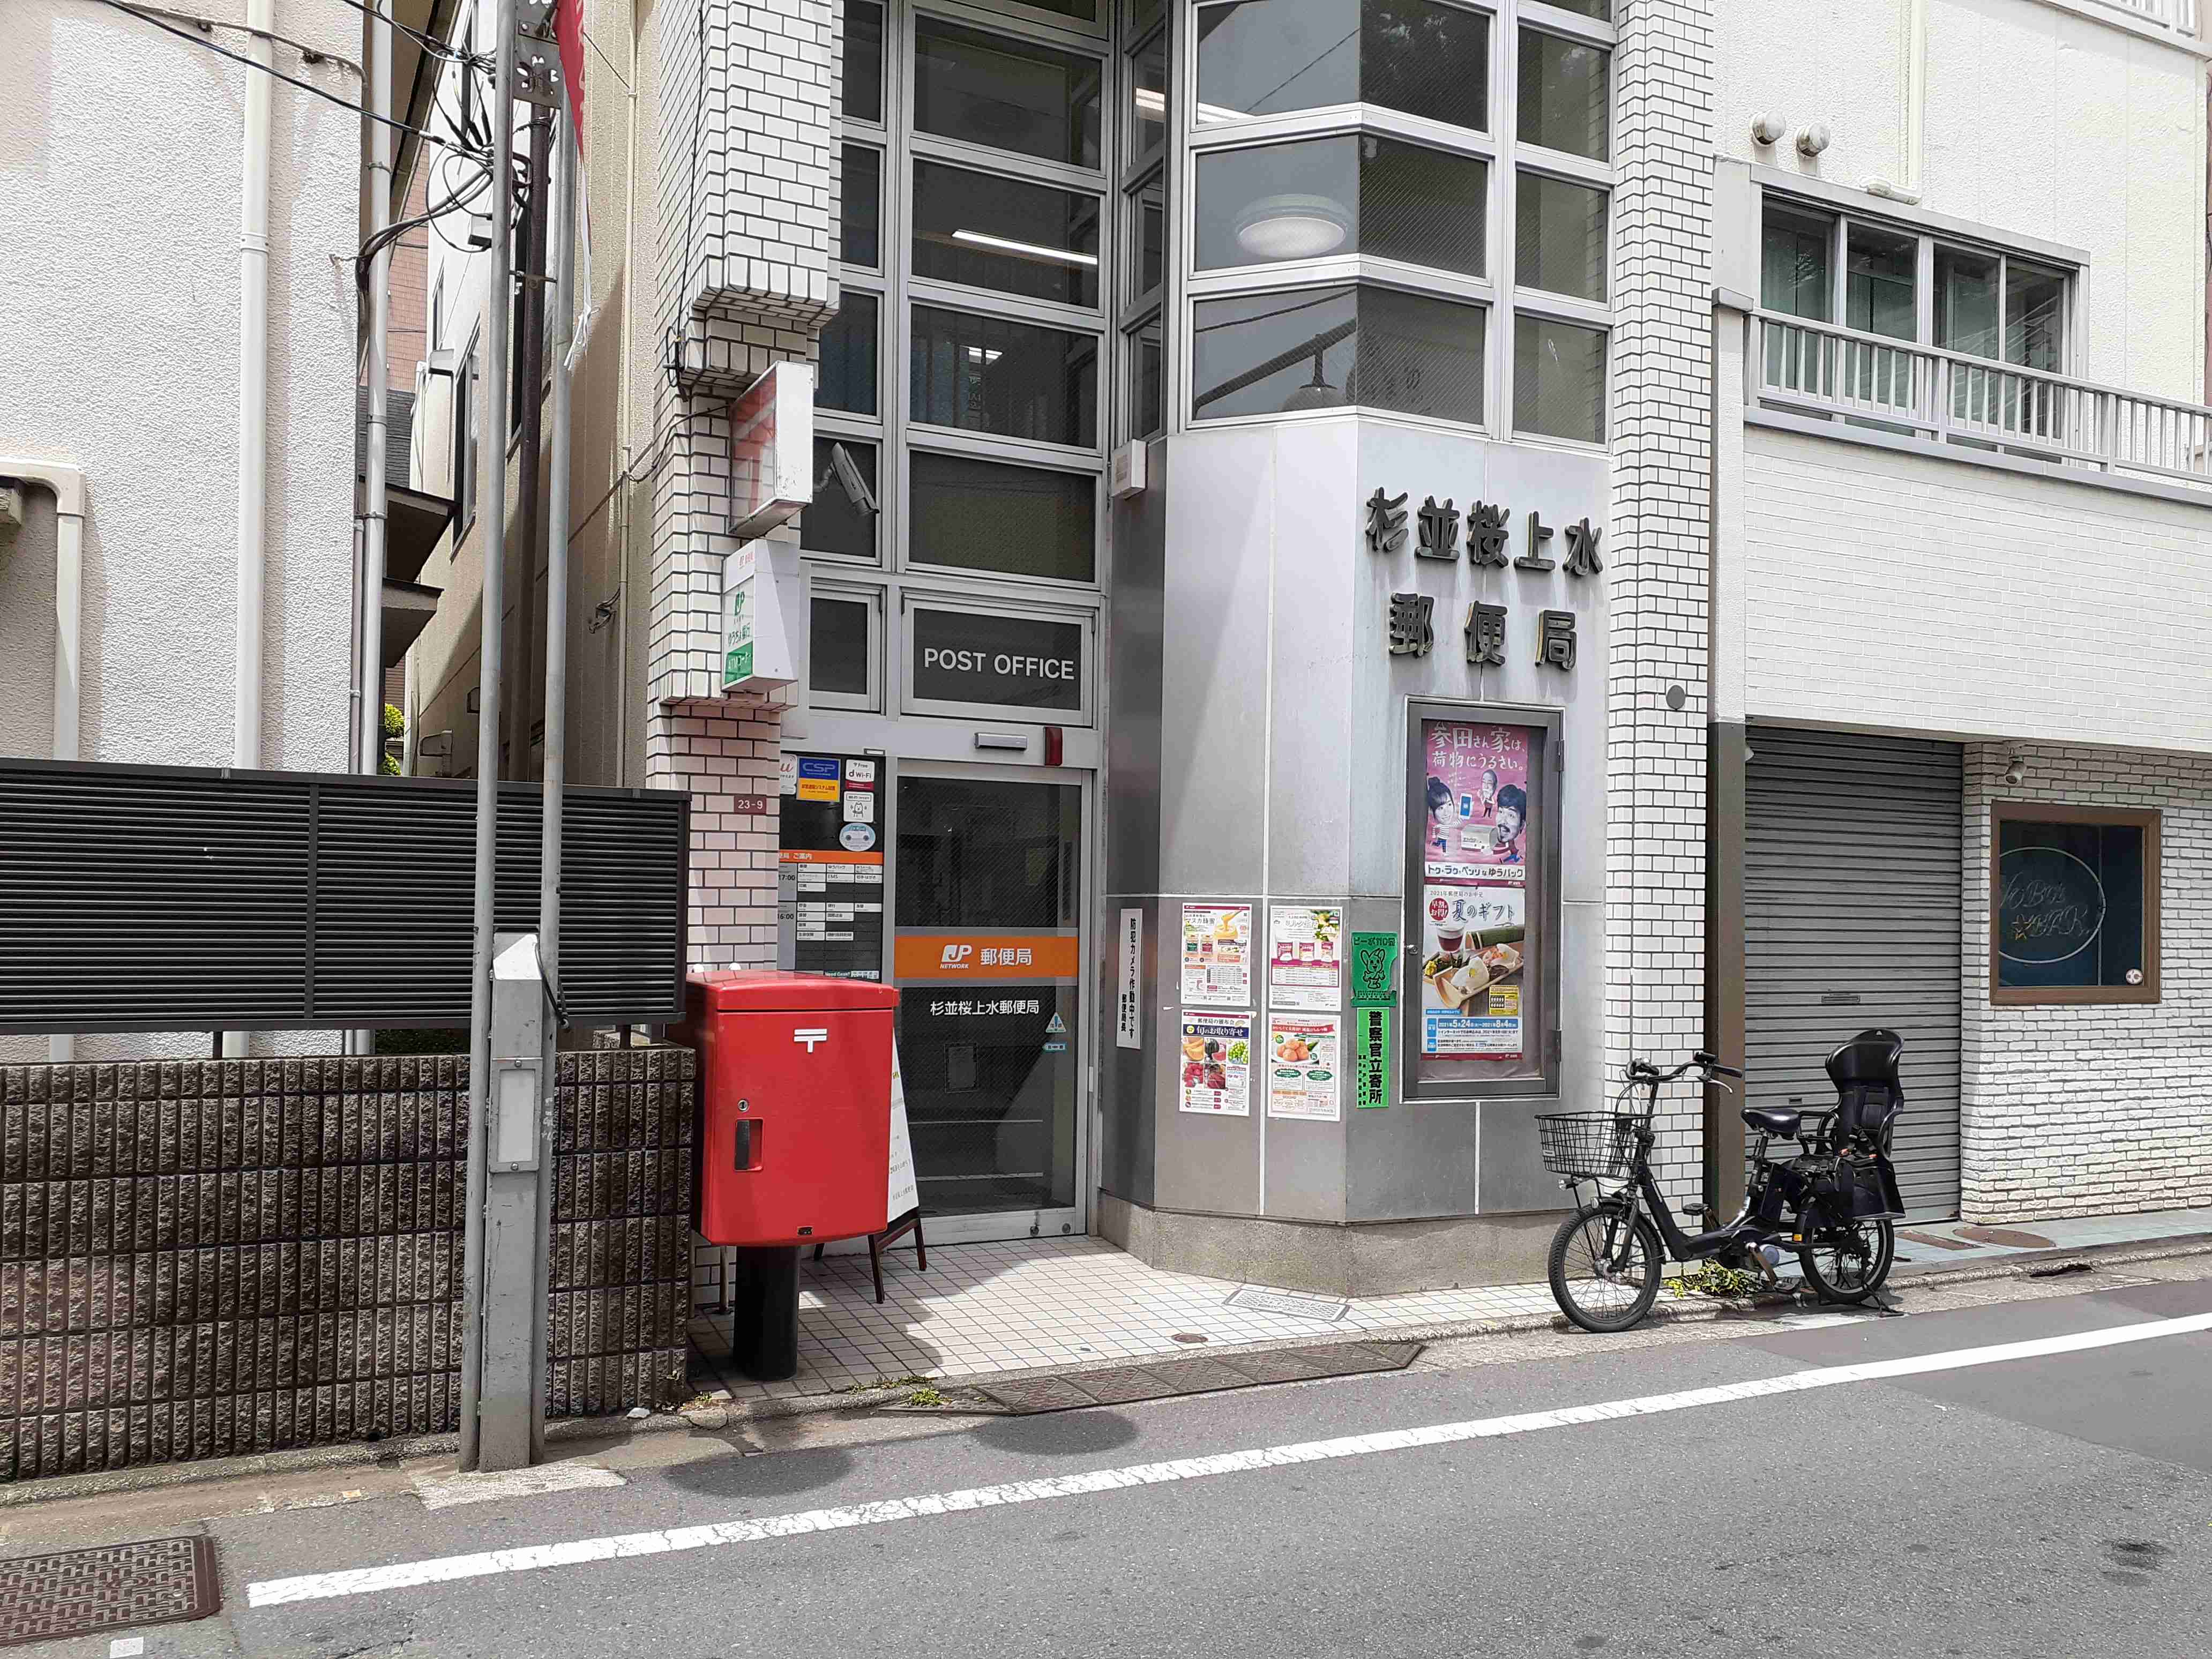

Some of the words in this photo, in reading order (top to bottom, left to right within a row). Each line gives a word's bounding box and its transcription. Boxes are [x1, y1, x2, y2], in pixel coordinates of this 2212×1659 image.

[1365, 487, 1603, 576] 杉並桜上水
[1388, 592, 1577, 670] 郵便局
[924, 647, 986, 672] POST
[994, 654, 1074, 679] OFFICE
[803, 763, 836, 773] CSP
[1432, 751, 1523, 771] 荷物にうるさい。
[737, 799, 764, 810] 23-9
[1452, 899, 1514, 923] 夏のギフト
[980, 948, 1032, 966] 郵便局
[1129, 918, 1137, 1039] 防犯カメラ作動中です
[930, 999, 1040, 1017] 杉並桜上水郵便局
[1369, 1011, 1382, 1104] 警察官立寄所
